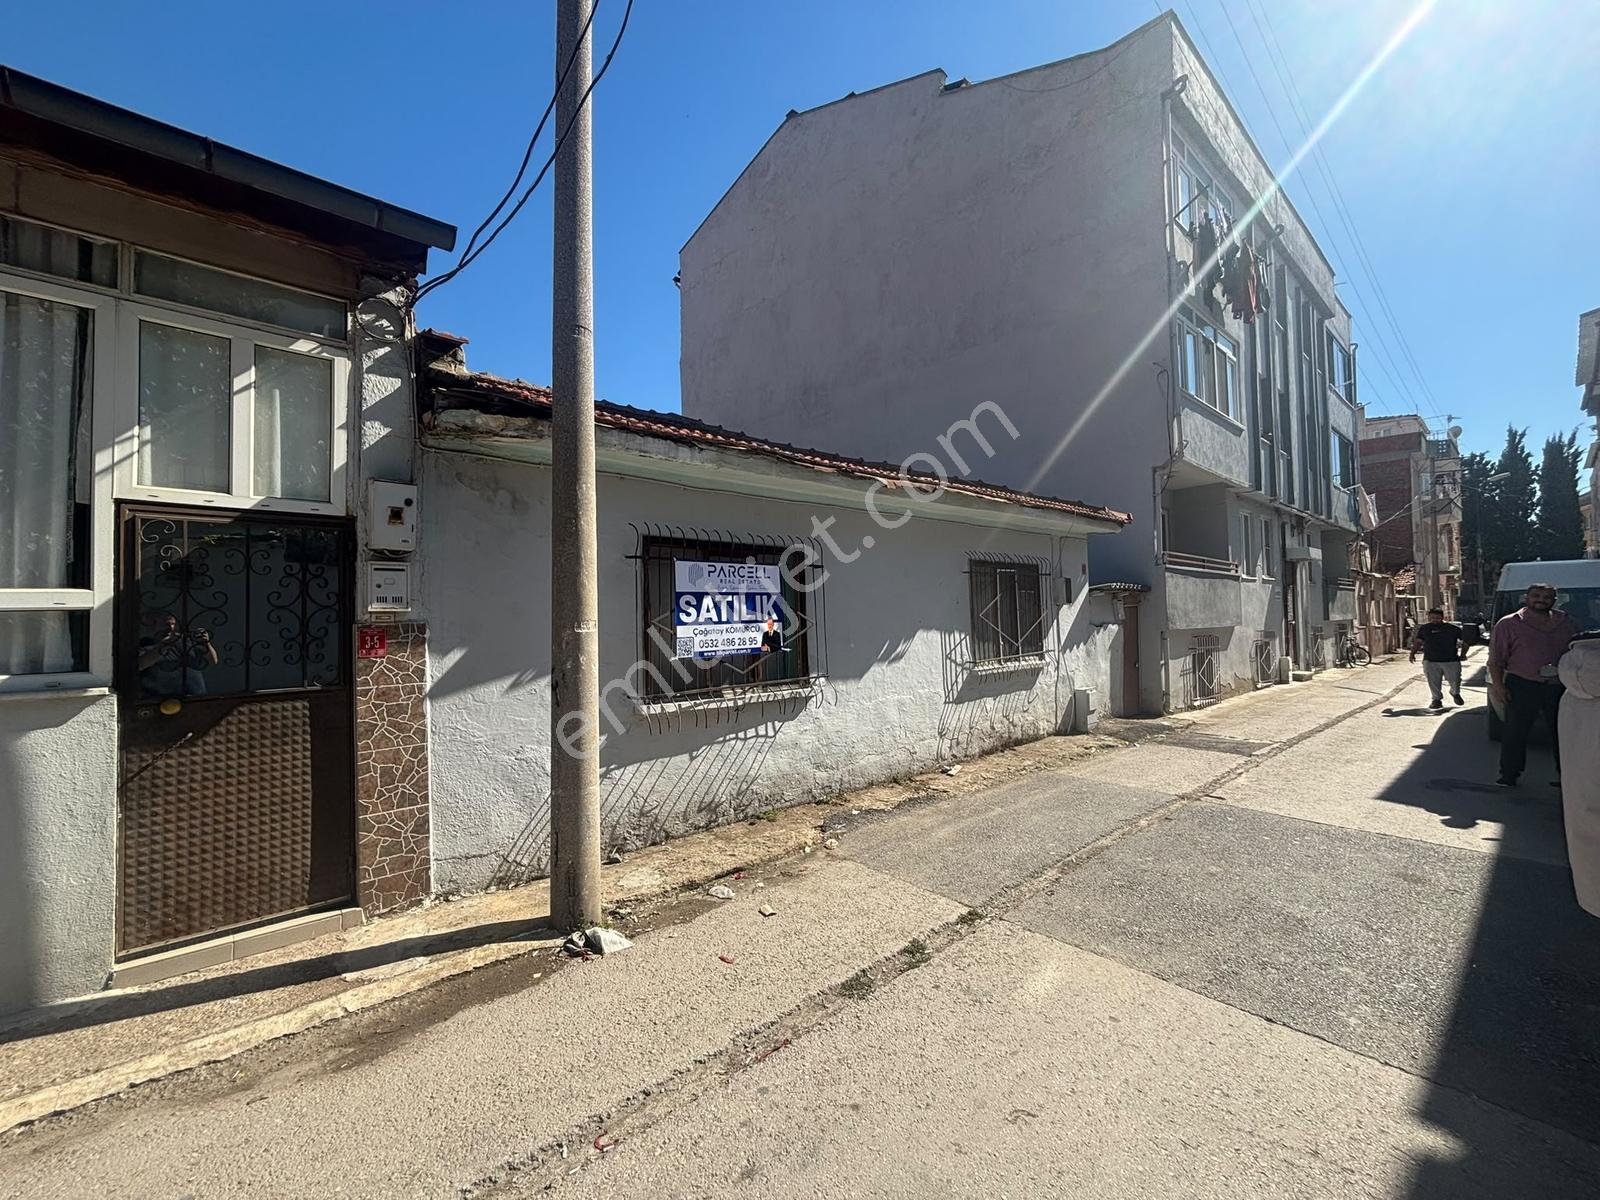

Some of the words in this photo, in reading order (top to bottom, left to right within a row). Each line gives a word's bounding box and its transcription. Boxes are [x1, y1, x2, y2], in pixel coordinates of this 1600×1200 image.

[707, 564, 771, 579] PARCELL
[365, 635, 380, 649] 3-5
[699, 638, 719, 649] 0532
[720, 637, 736, 648] 486
[737, 637, 748, 647] 28
[748, 636, 758, 646] 95
